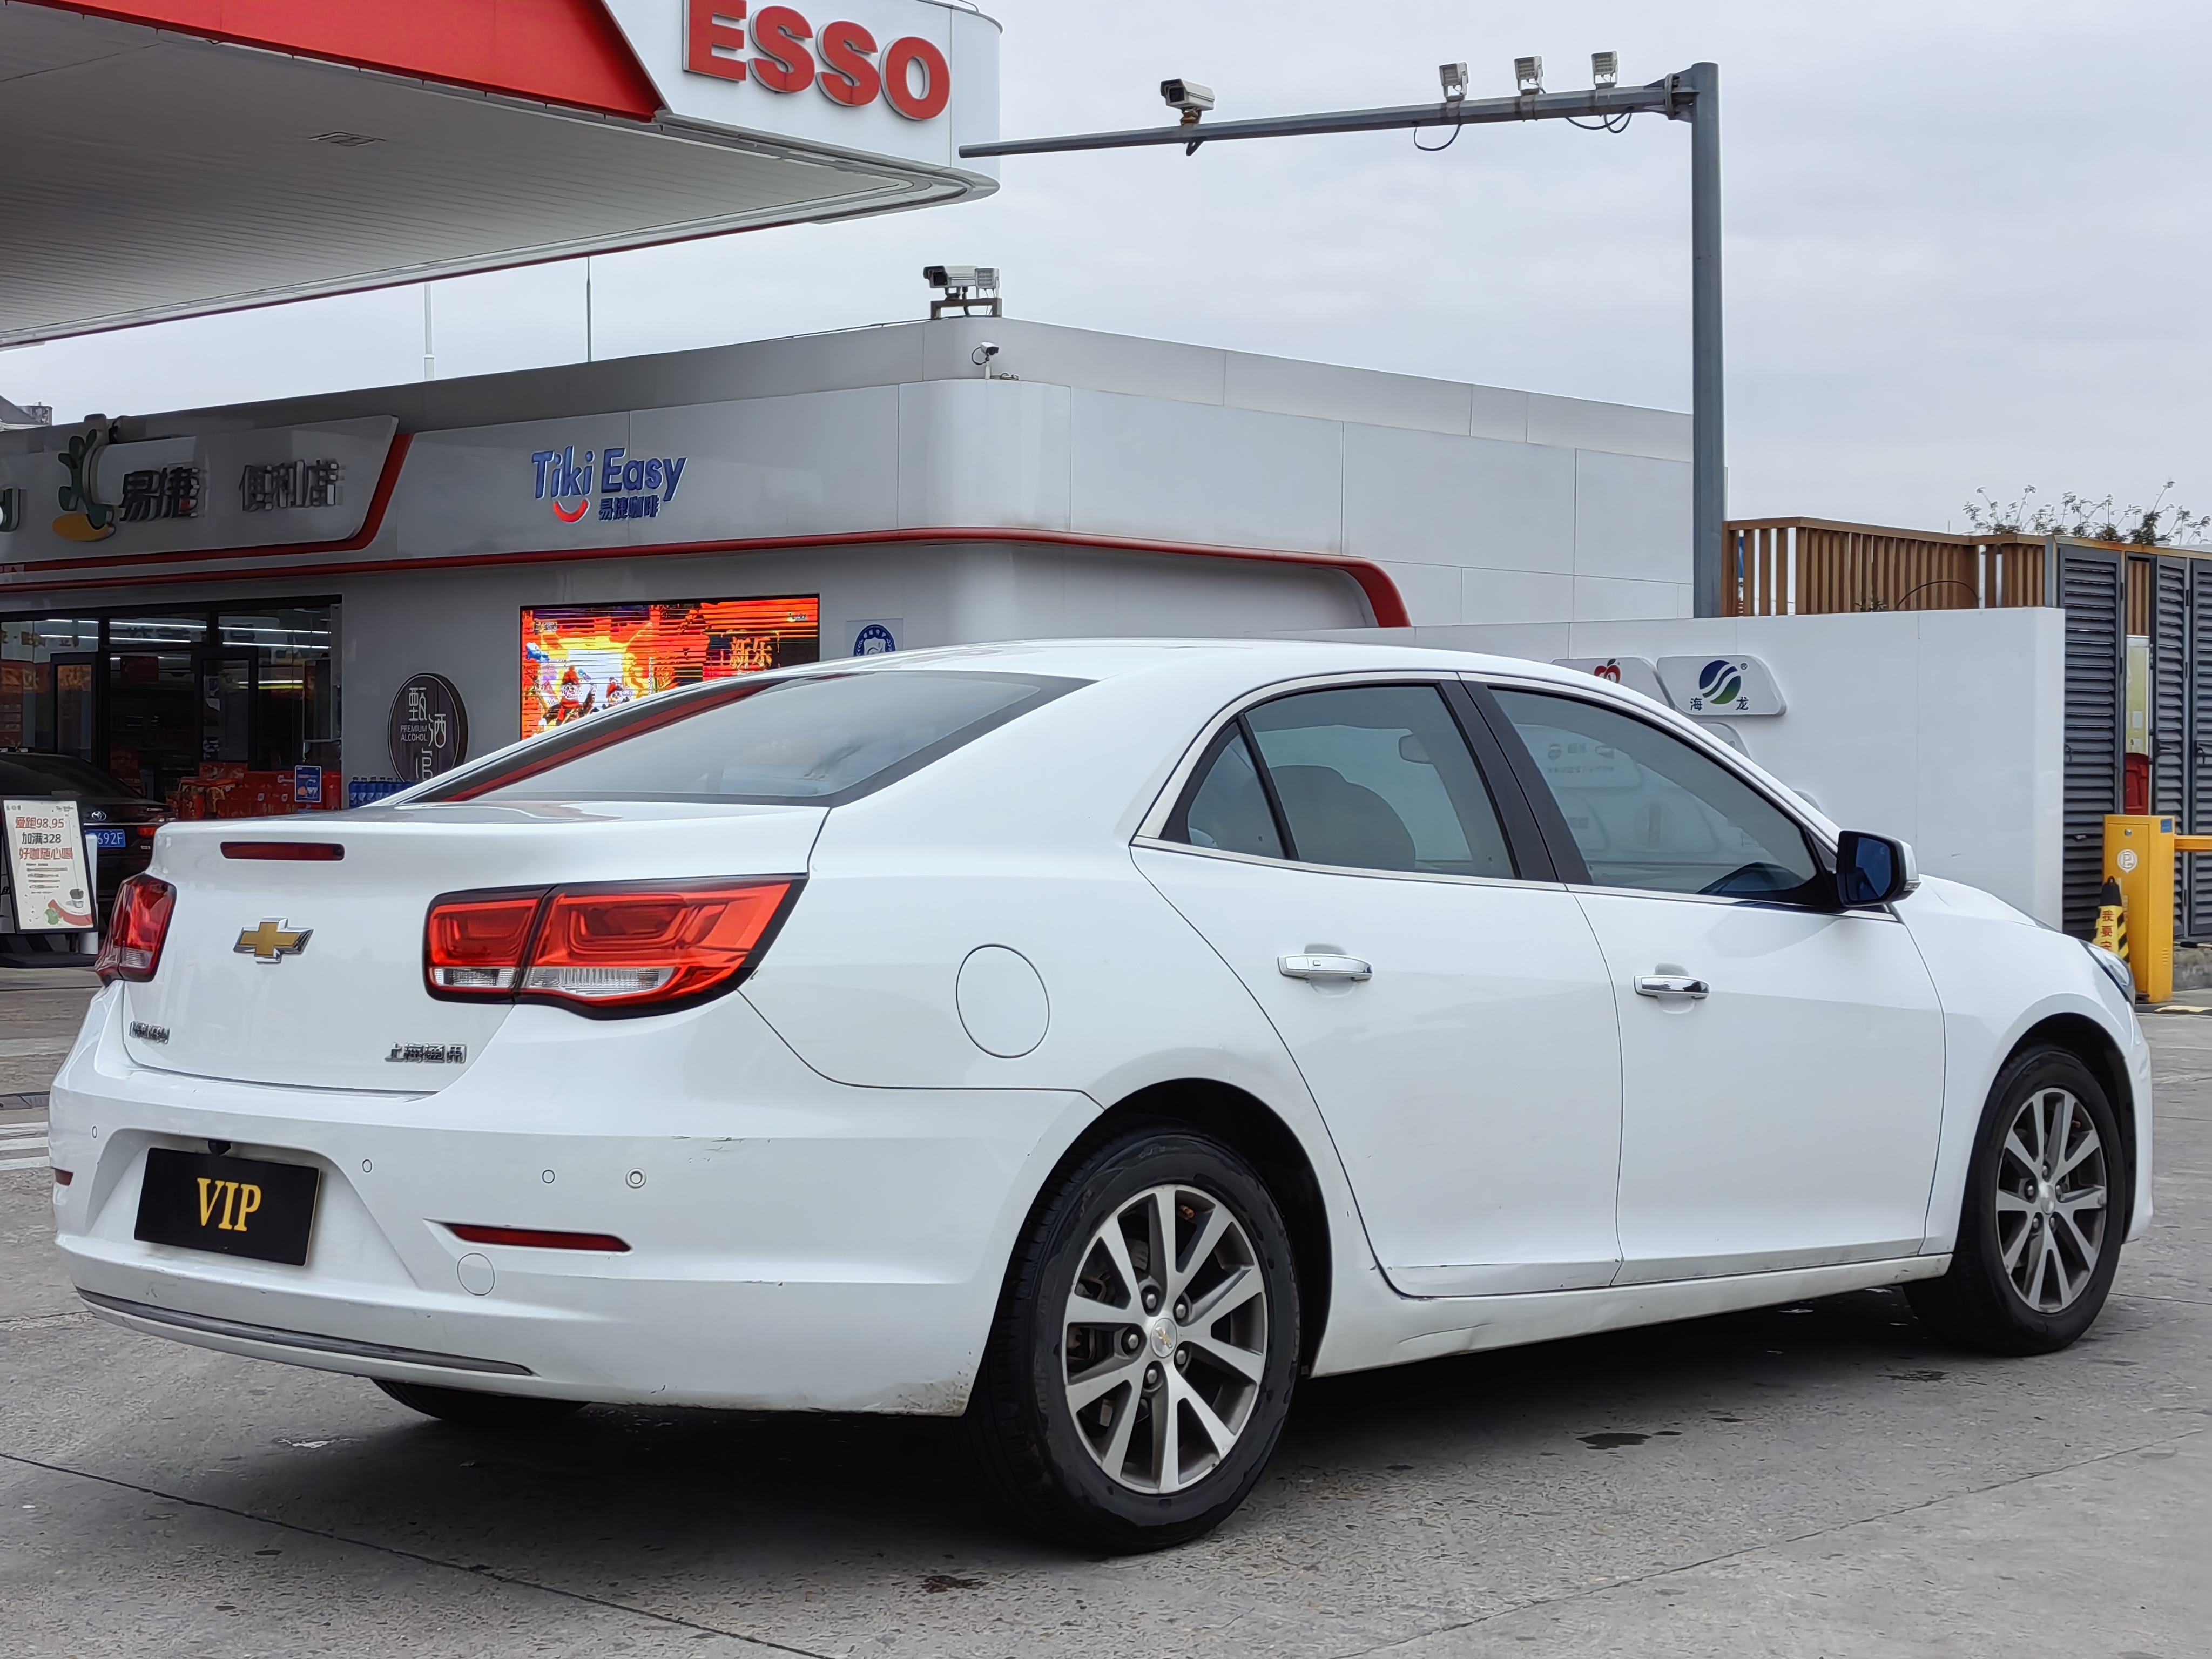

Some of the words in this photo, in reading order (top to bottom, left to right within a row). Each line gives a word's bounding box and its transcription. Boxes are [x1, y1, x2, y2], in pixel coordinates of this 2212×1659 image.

[684, 0, 950, 120] ESSO
[531, 446, 594, 499] Tiki
[601, 447, 687, 502] Easy
[400, 733, 427, 741] ALCOHOL
[384, 1042, 467, 1063] 上海通用
[197, 1177, 261, 1231] VIP
